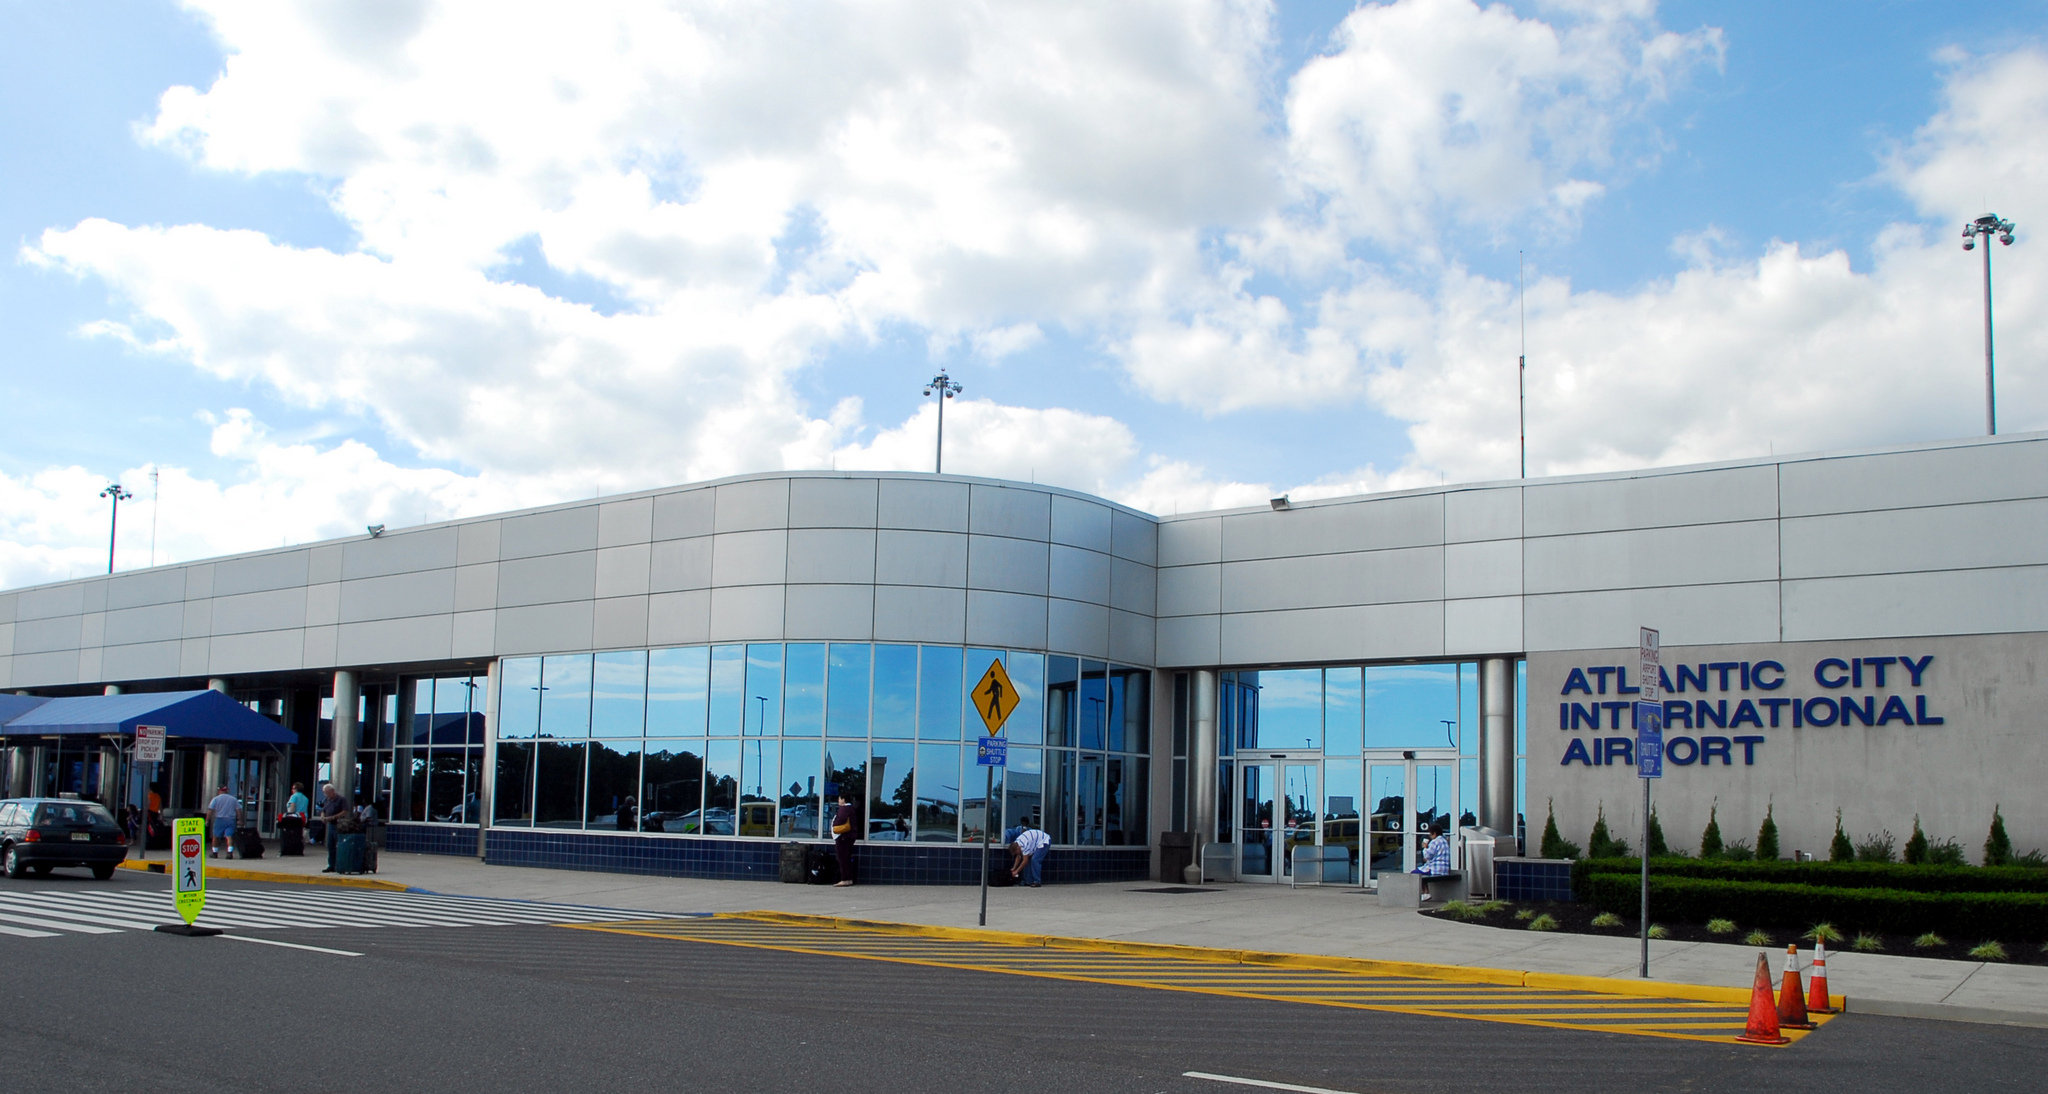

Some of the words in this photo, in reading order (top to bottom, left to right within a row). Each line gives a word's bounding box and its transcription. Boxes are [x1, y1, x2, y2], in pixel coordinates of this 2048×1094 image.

[1646, 633, 1653, 647] NO
[1641, 647, 1658, 663] PARKING
[1560, 660, 1785, 694] ATLANTIC
[1814, 655, 1934, 687] CITY
[1642, 674, 1657, 687] SHUTTLE
[1645, 687, 1653, 697] STOP
[1560, 695, 1944, 729] INTRNATIONAL
[1560, 735, 1764, 766] AIRORT
[1641, 743, 1658, 756] SHUTTLE
[990, 756, 1001, 764] STOP
[1644, 759, 1654, 772] STOP
[182, 844, 199, 853] STOP
